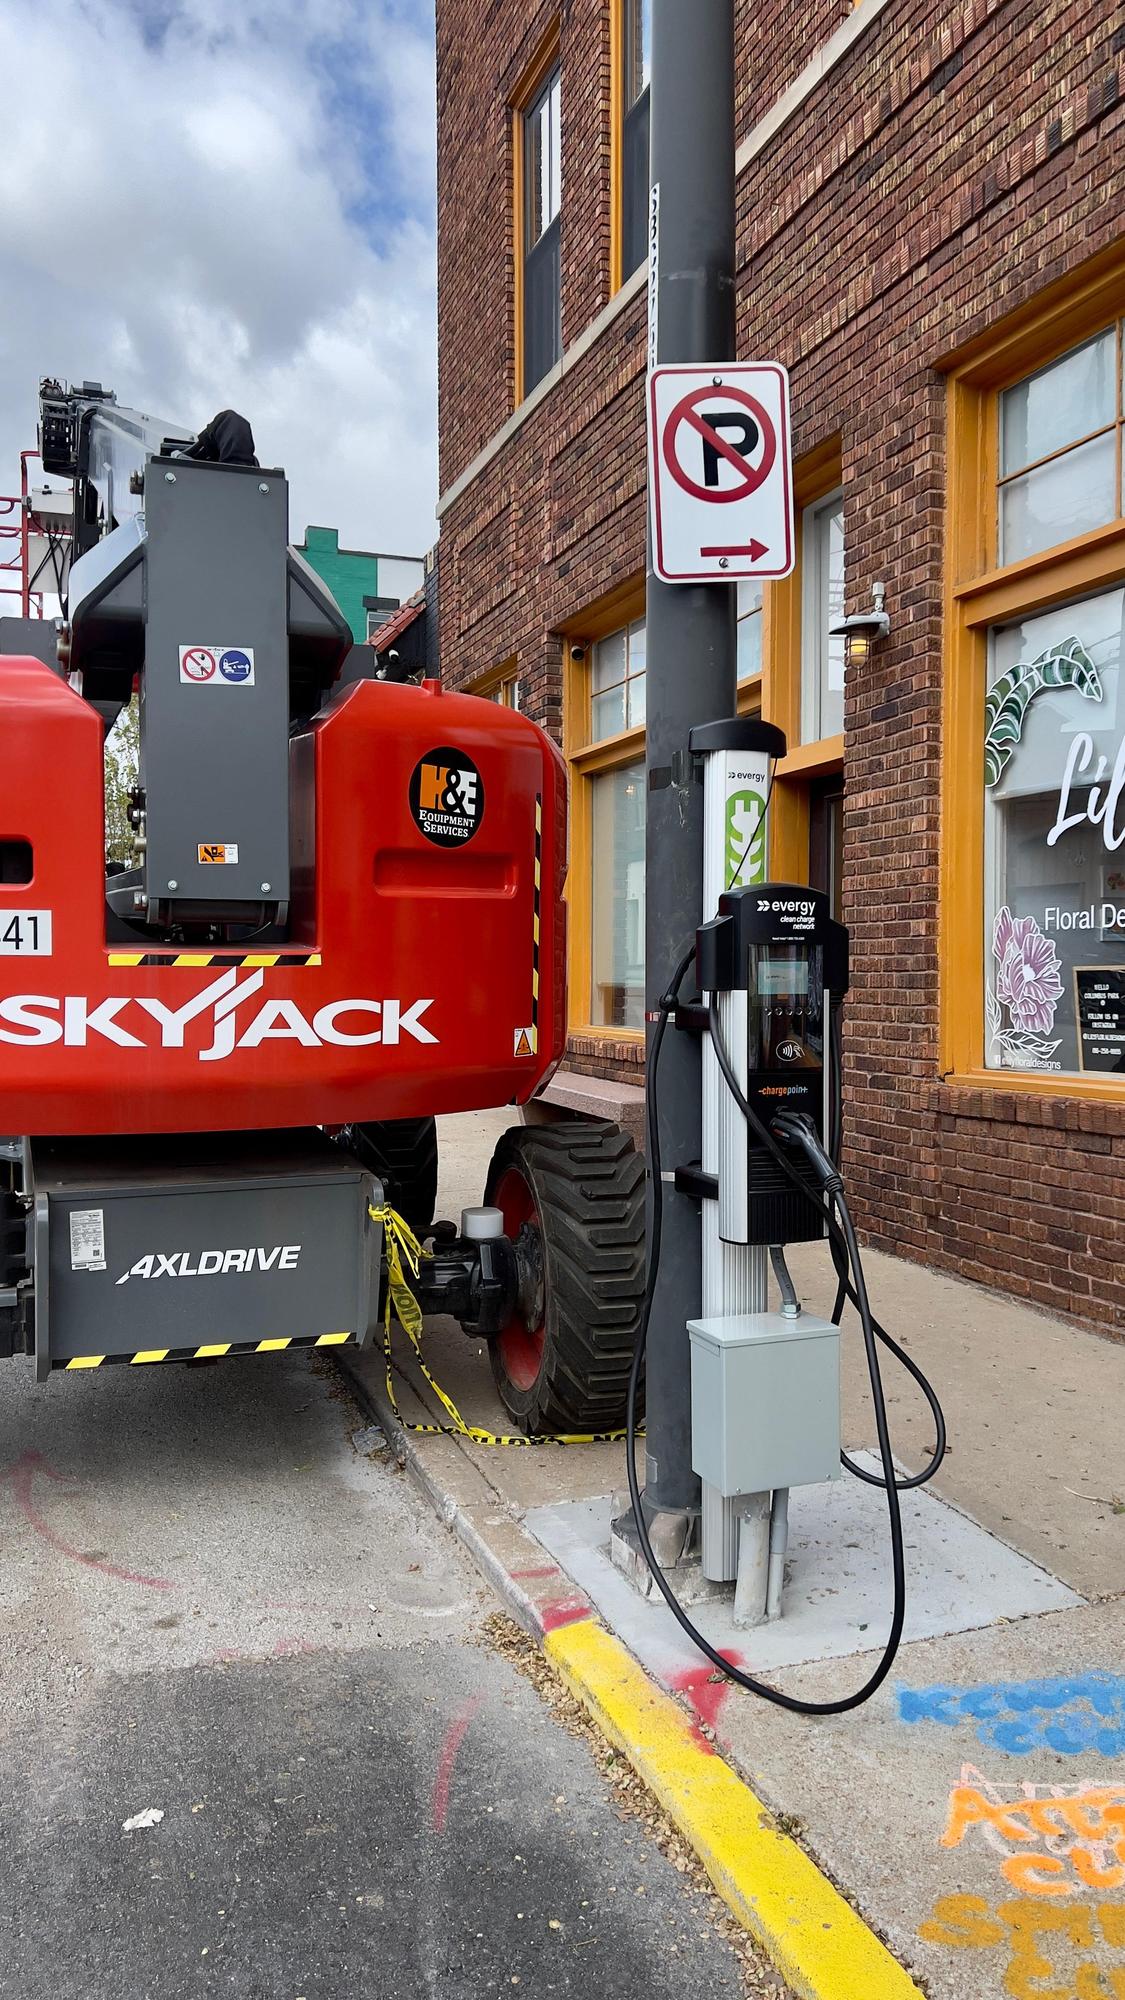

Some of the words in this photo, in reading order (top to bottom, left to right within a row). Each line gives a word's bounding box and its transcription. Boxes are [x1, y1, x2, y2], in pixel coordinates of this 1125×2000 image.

[701, 411, 760, 487] P
[419, 763, 478, 817] H&E
[736, 771, 766, 783] evergy
[418, 808, 476, 828] EQUIPMENT
[423, 821, 469, 838] SERVICES
[771, 901, 816, 915] evergy
[797, 916, 815, 924] charge
[1044, 905, 1095, 931] Floral
[0, 915, 38, 950] 41
[0, 966, 440, 1061] SKYJACK
[115, 1245, 302, 1285] AXLDRIVE
